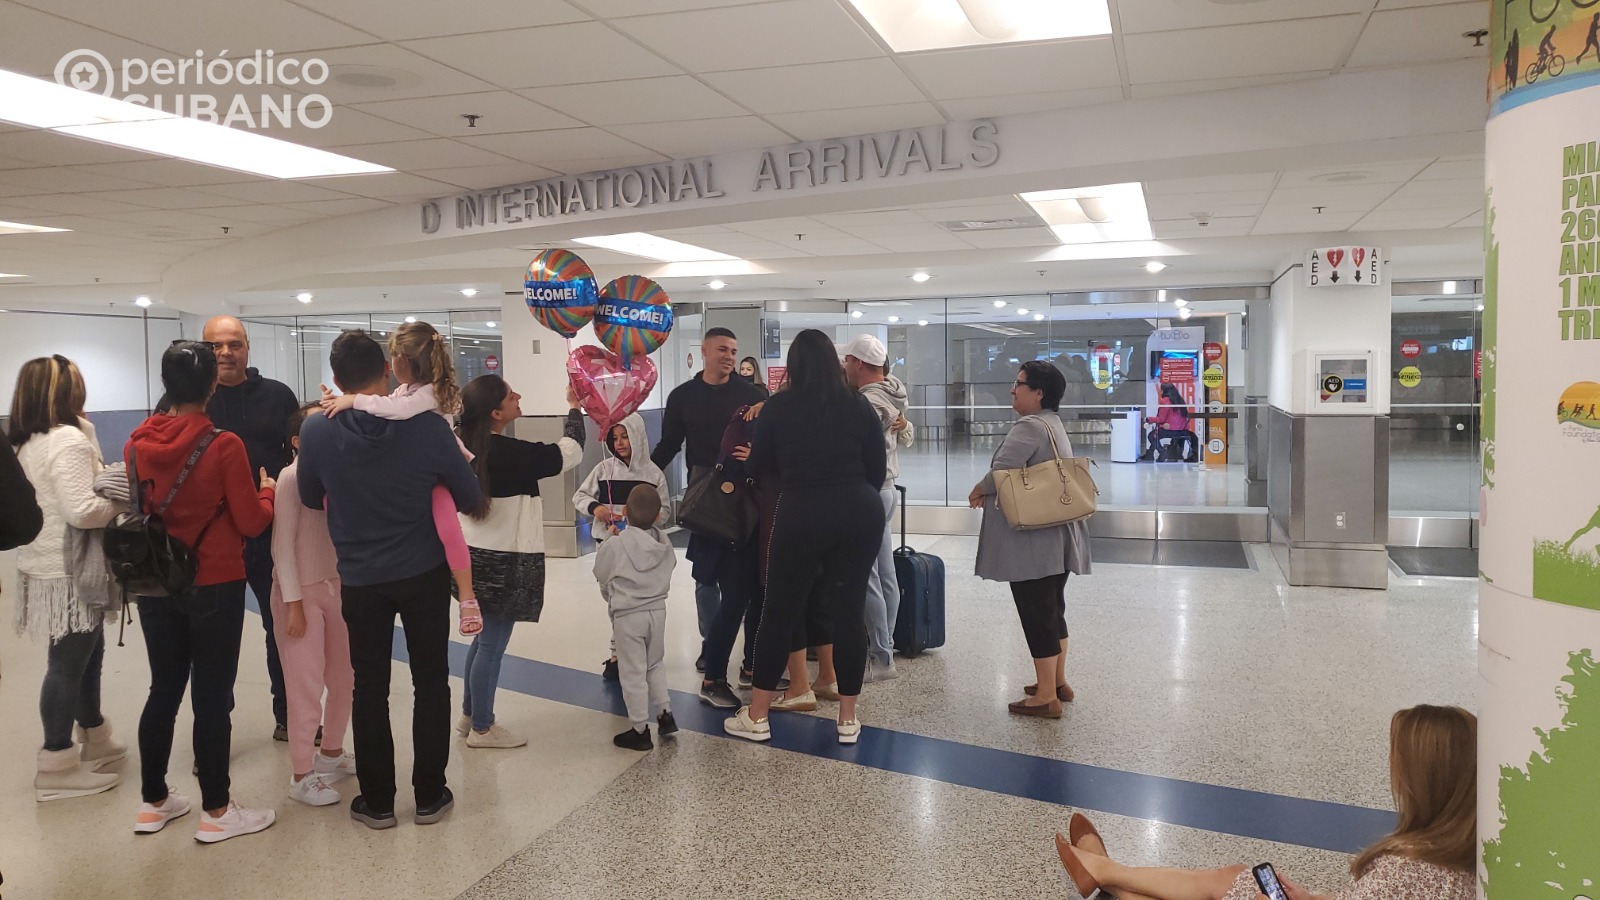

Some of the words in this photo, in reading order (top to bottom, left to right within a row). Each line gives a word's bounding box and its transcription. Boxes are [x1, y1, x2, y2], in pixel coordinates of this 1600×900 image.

[420, 199, 442, 235] D
[453, 157, 725, 230] INTERNATIONAL
[751, 119, 1003, 193] ARRIVALS
[1560, 207, 1600, 243] 26
[1558, 278, 1571, 308] 1
